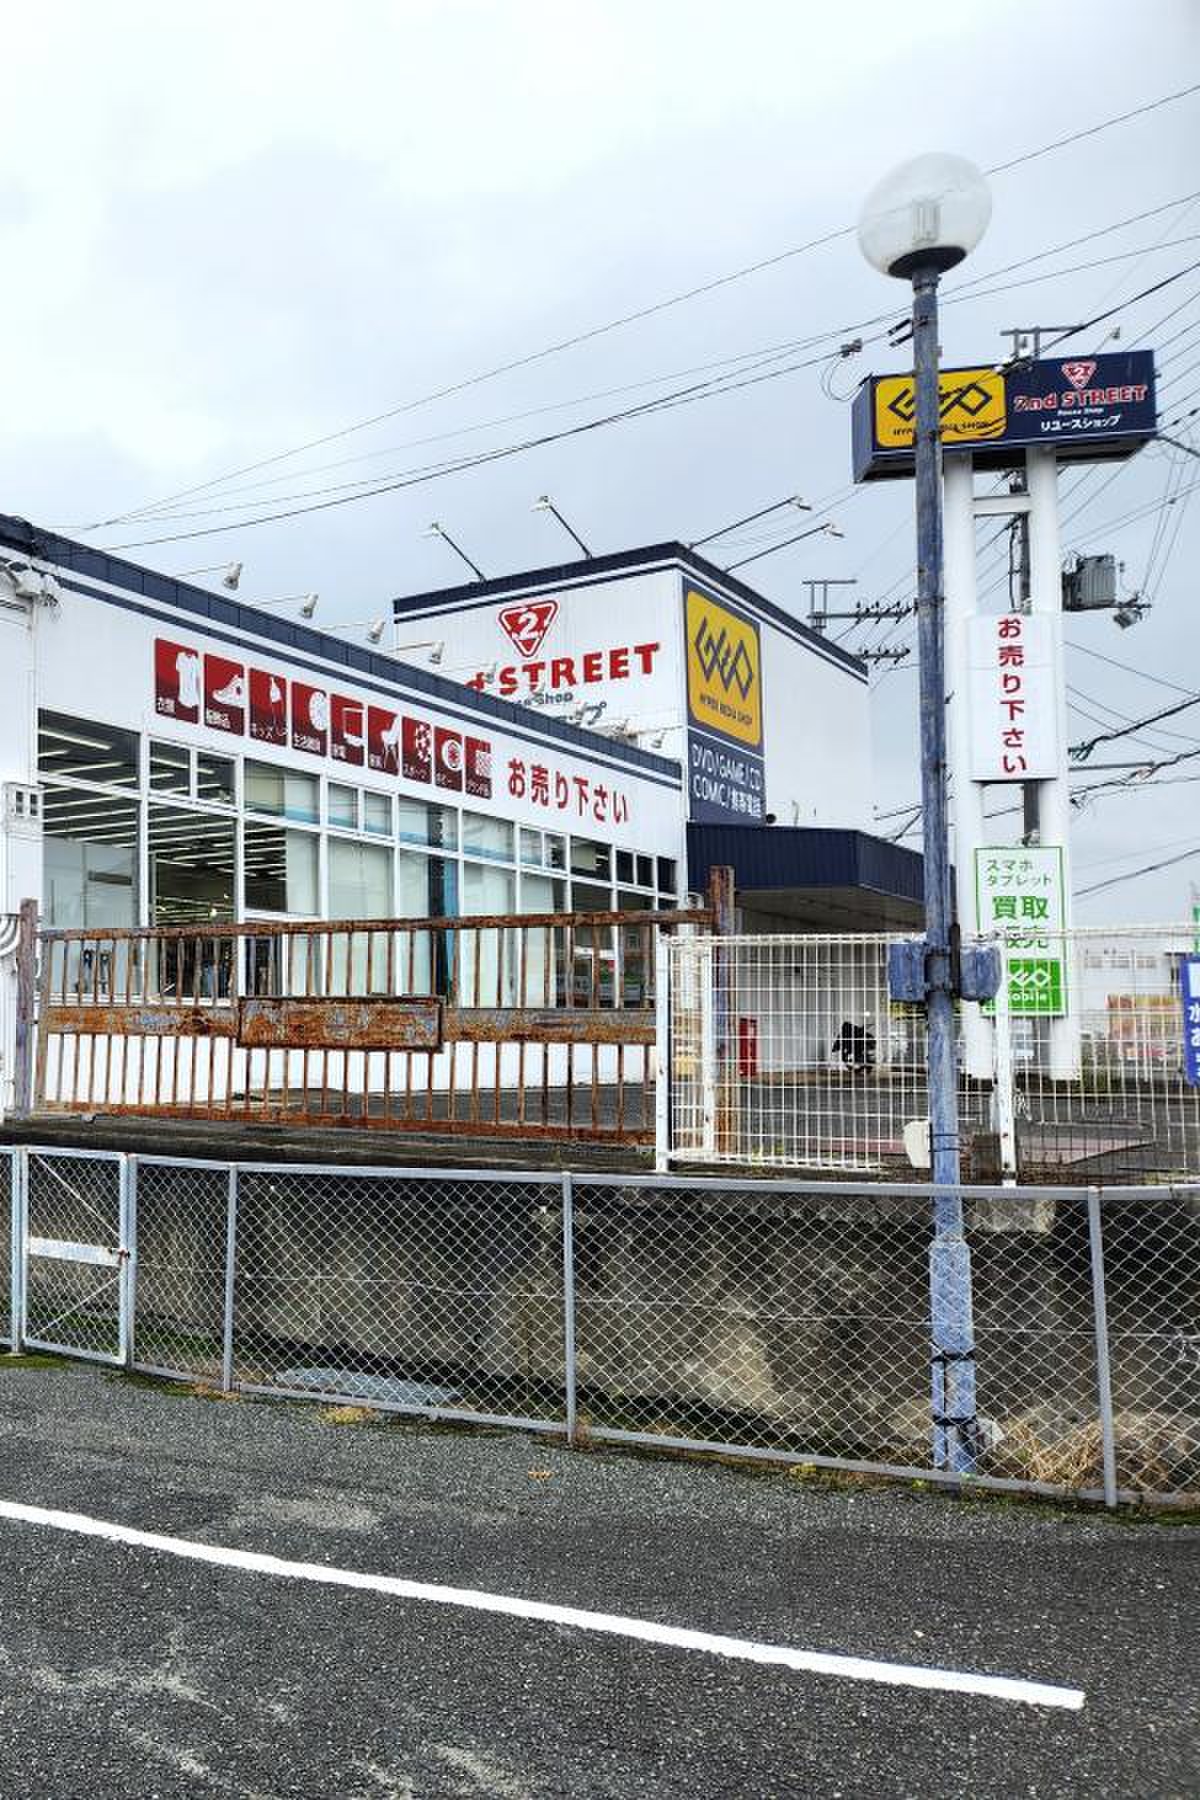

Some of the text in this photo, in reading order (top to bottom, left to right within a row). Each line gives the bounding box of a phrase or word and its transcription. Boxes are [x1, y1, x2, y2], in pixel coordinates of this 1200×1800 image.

[1061, 384, 1148, 408] STREET
[1041, 415, 1121, 433] リユースショップ
[518, 611, 542, 640] 2
[499, 643, 660, 696] STREET
[997, 617, 1028, 774] お売り下さい
[508, 758, 628, 824] お売り下さい
[987, 859, 1033, 871] スマホ
[987, 875, 1052, 887] タブレット
[992, 895, 1050, 920] 買取
